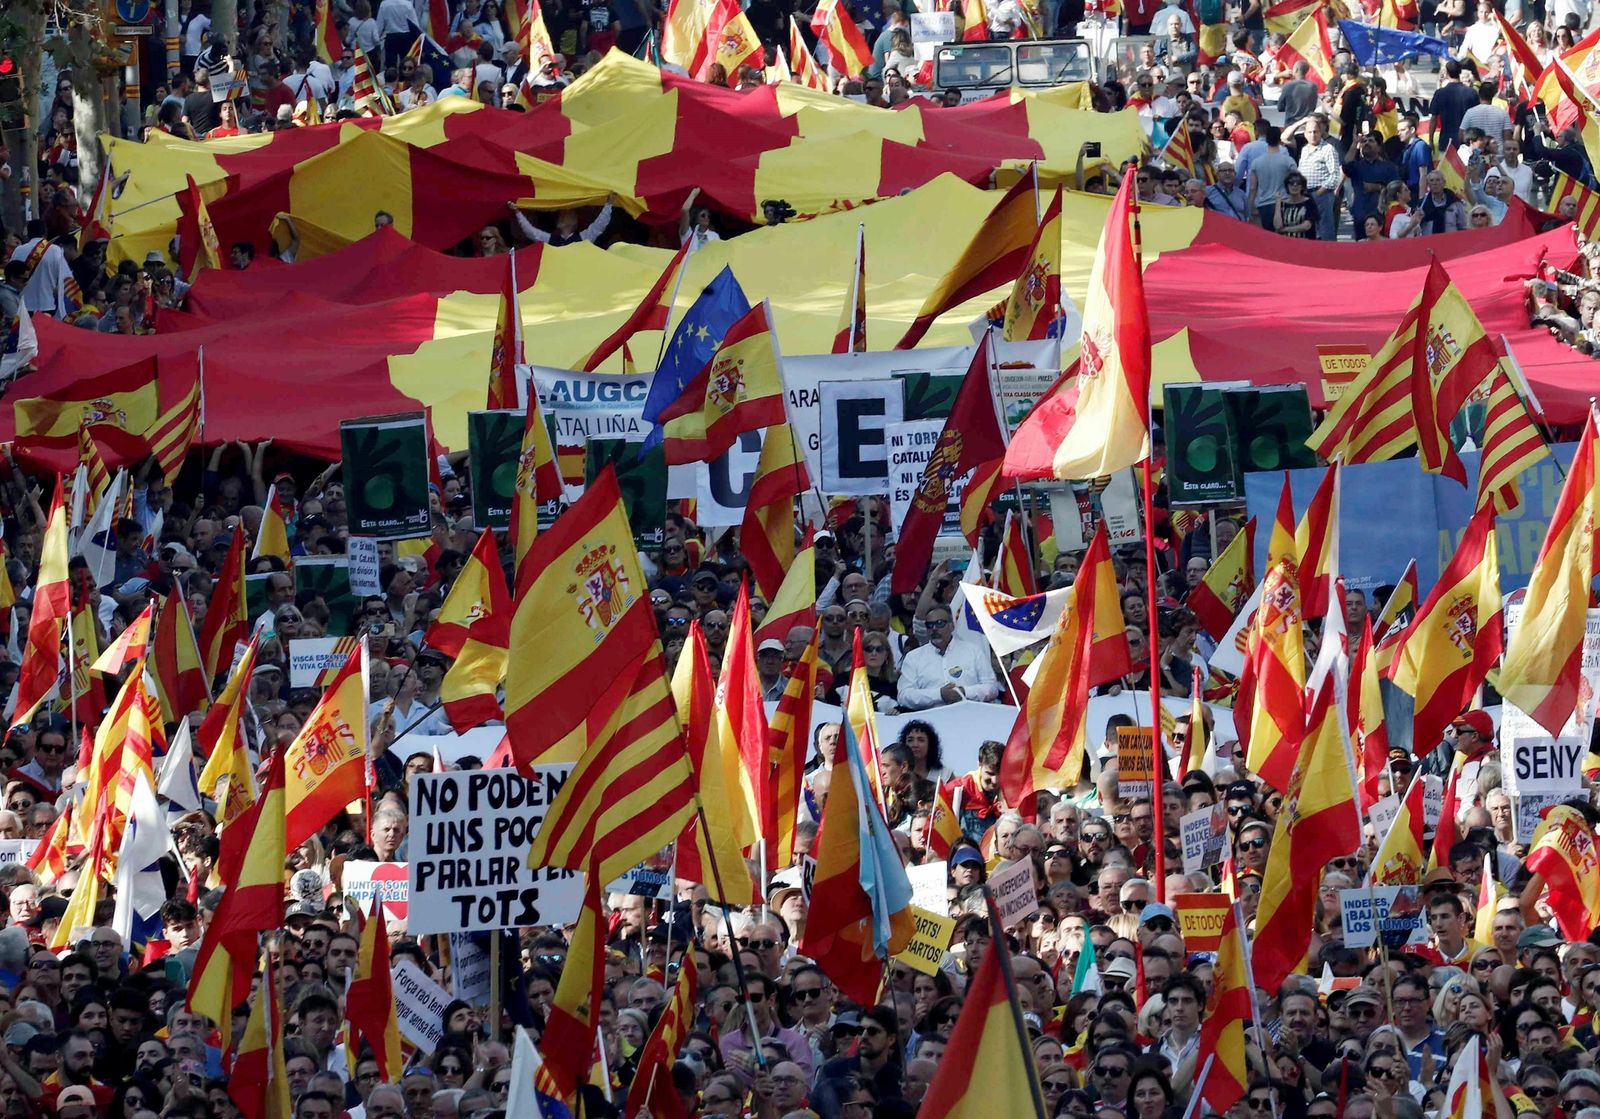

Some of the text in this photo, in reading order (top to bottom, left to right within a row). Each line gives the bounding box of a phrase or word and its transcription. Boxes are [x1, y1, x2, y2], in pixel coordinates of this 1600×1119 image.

[1325, 358, 1367, 369] DE TODOS
[550, 379, 648, 402] AUGC
[836, 397, 889, 479] E
[891, 431, 938, 447] NI TORR
[892, 450, 931, 465] CATALU
[901, 472, 913, 484] NI
[895, 487, 910, 501] ÉS
[1515, 745, 1582, 780] SENY
[416, 770, 568, 817] NO PODEN
[426, 815, 543, 855] UNS POC
[1186, 844, 1202, 859] ELS
[415, 856, 520, 892] PARLAR
[631, 869, 671, 886] HUMOS!
[348, 880, 408, 890] JUNTOS SOM
[348, 890, 408, 901] IMPAABL
[451, 887, 541, 928] TOTS
[912, 914, 942, 939] ARTS!
[1347, 921, 1372, 933] LOS
[394, 967, 417, 995] Força
[428, 996, 447, 1018] teni
[408, 1012, 428, 1034] sensa
